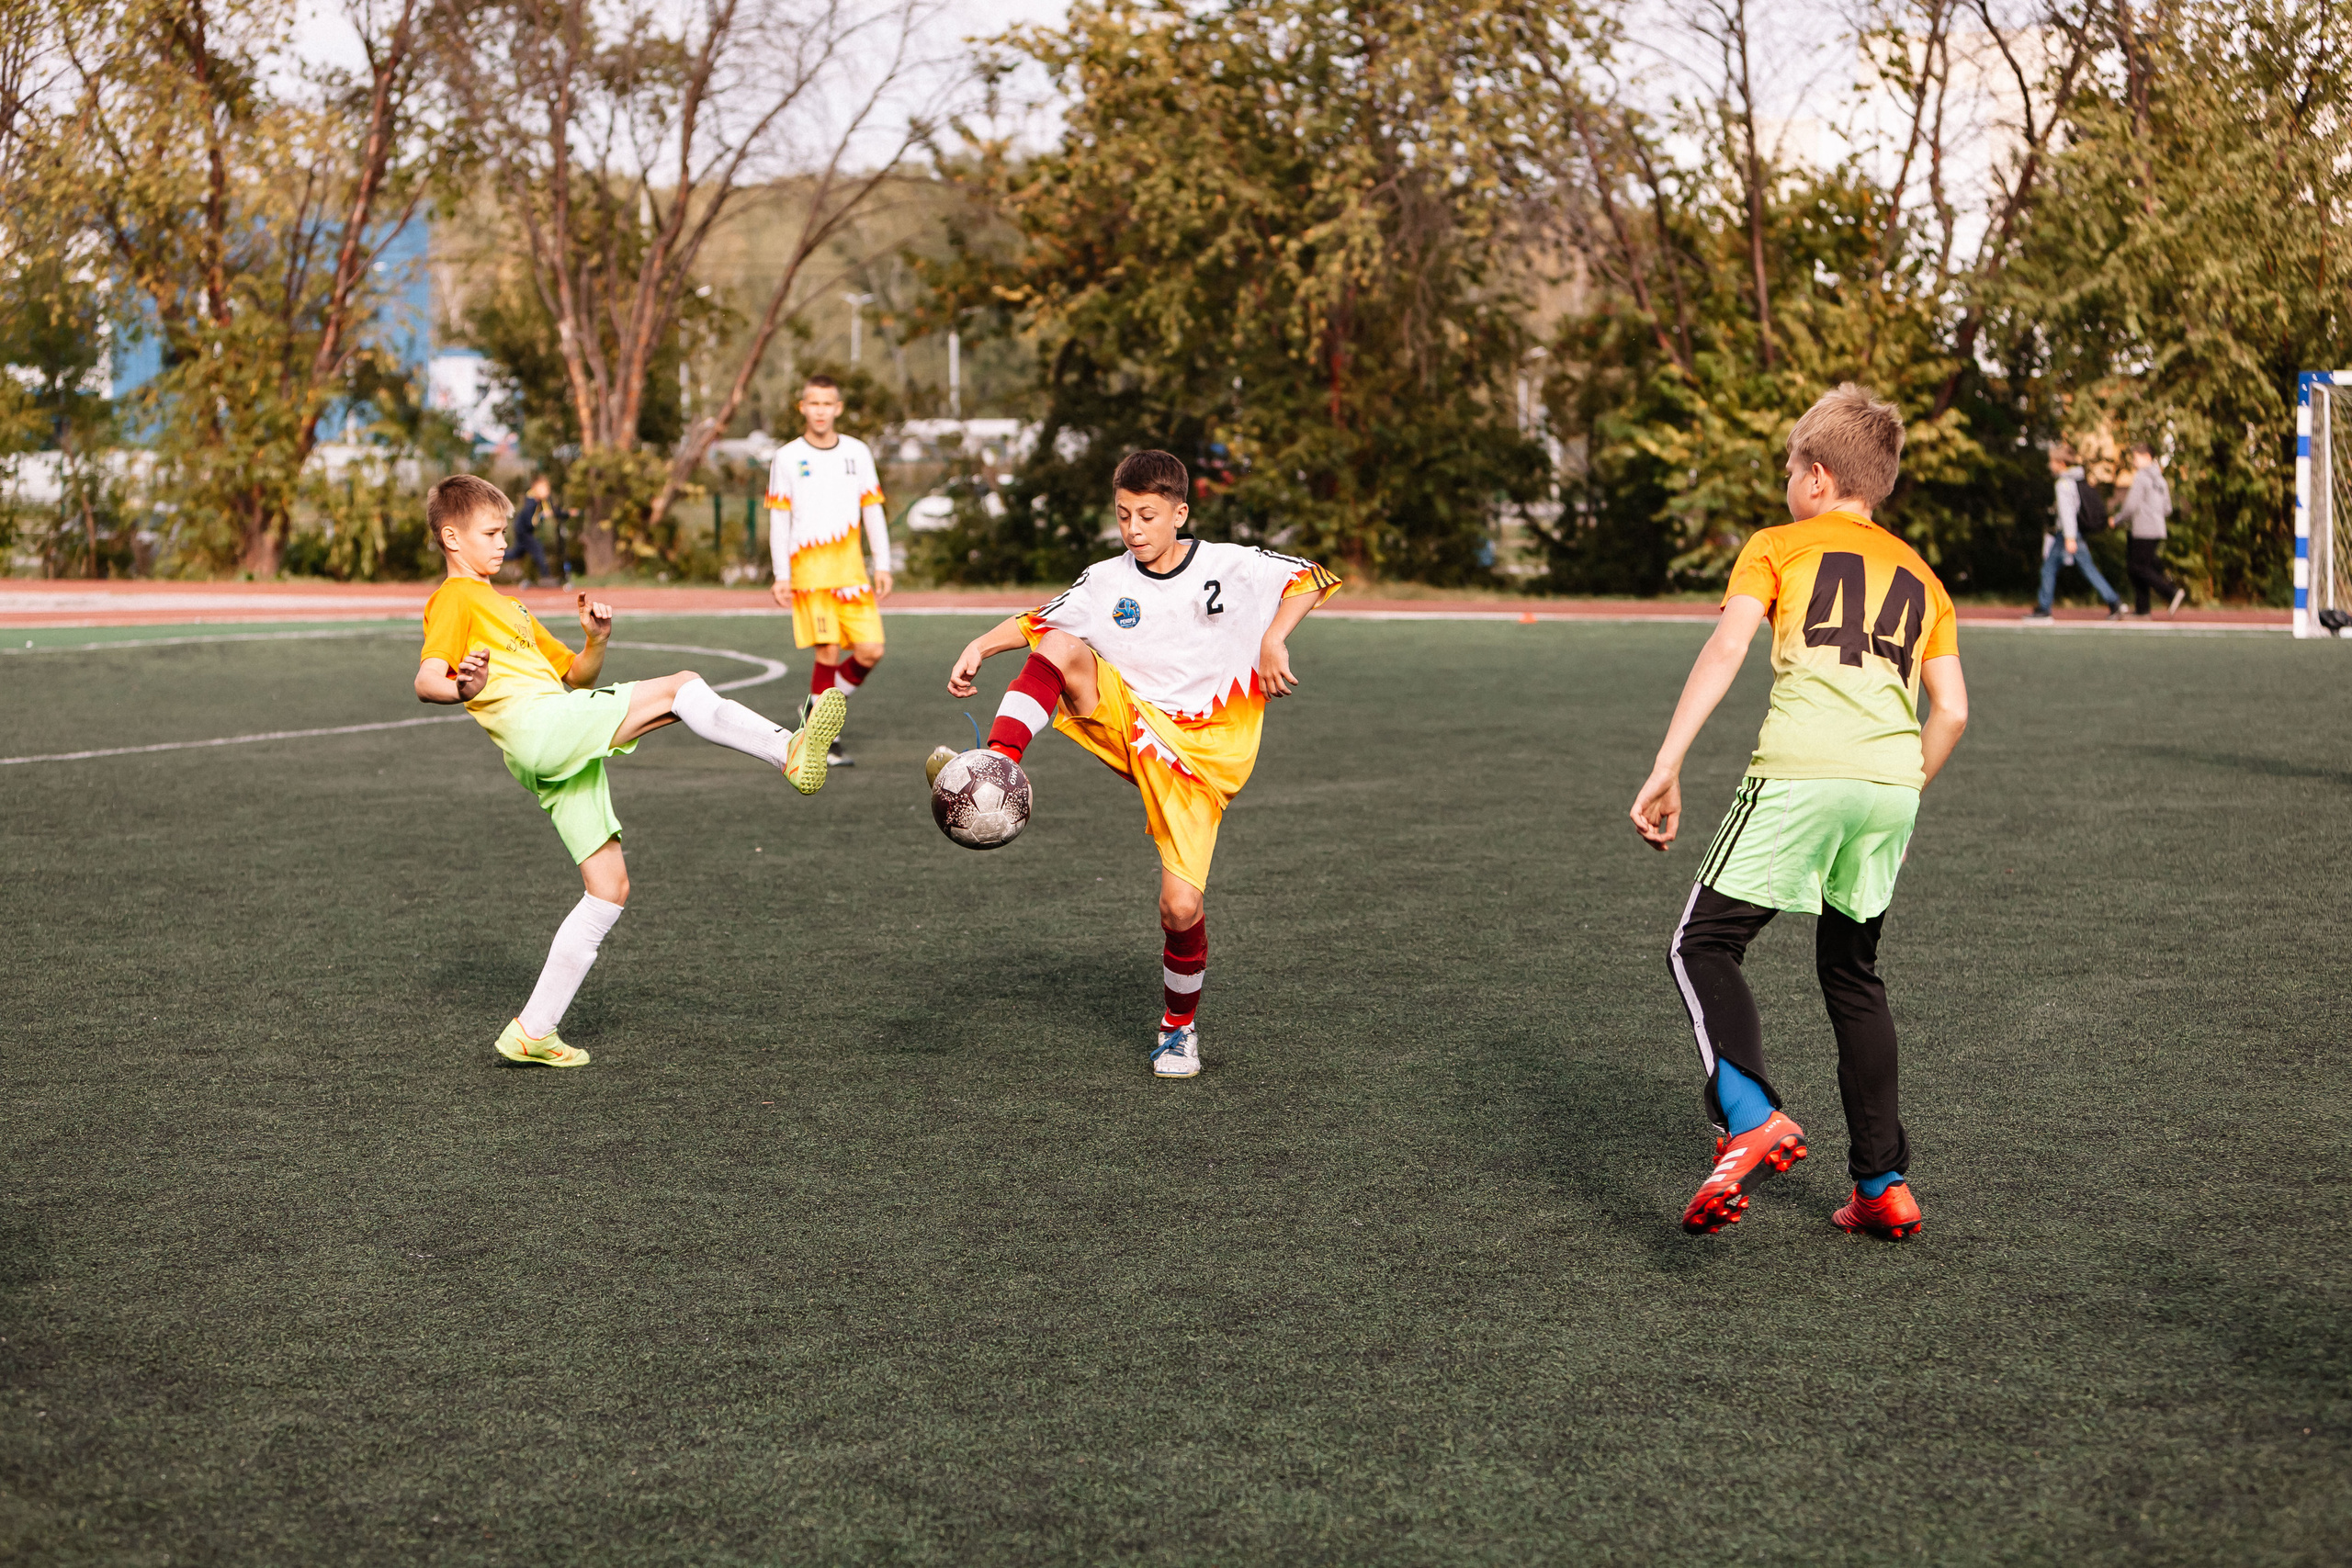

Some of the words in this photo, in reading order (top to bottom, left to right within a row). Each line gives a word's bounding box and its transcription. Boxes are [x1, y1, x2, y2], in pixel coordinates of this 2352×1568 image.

[844, 457, 856, 475] 11
[1204, 580, 1224, 615] 2
[817, 616, 827, 633] 11
[1803, 551, 1927, 689] 44
